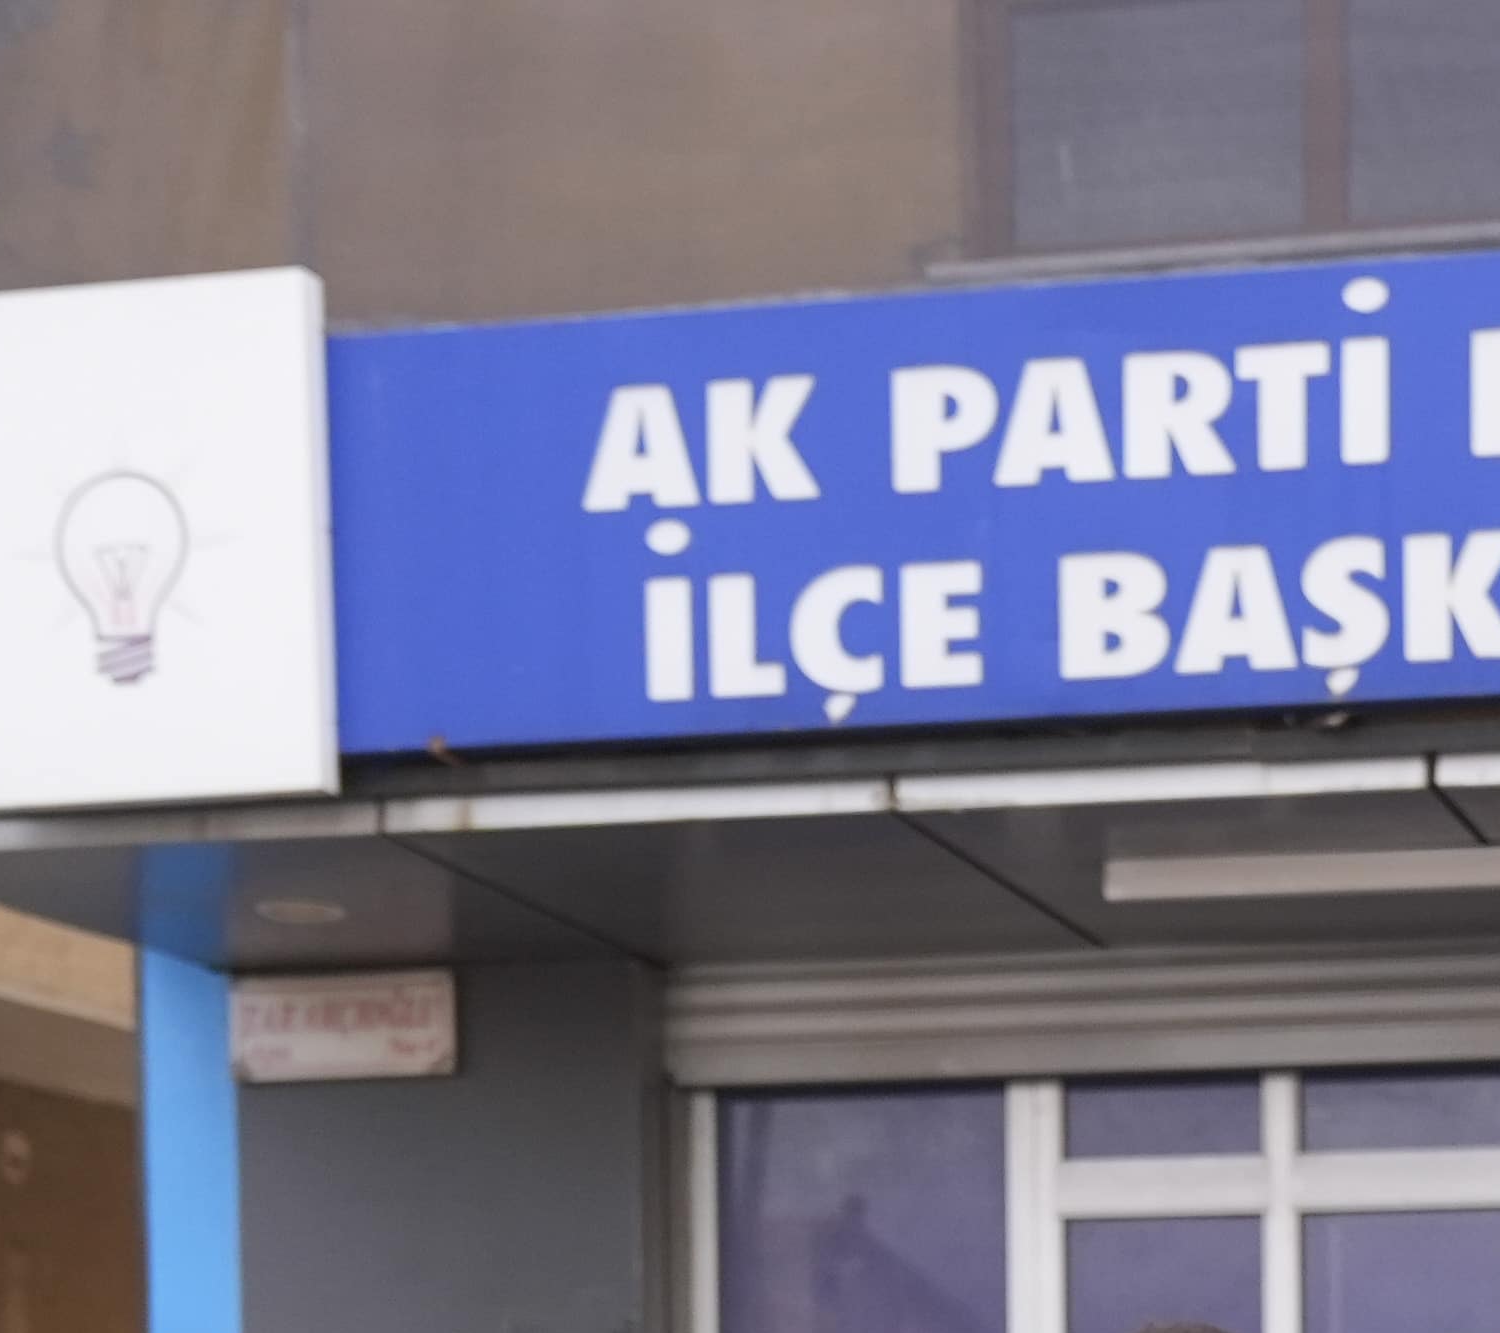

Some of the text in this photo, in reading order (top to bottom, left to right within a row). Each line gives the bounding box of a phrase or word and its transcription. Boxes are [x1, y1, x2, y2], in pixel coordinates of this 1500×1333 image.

[582, 373, 822, 514] AK
[890, 276, 1392, 495] PARTİ
[644, 518, 985, 727] İLÇE
